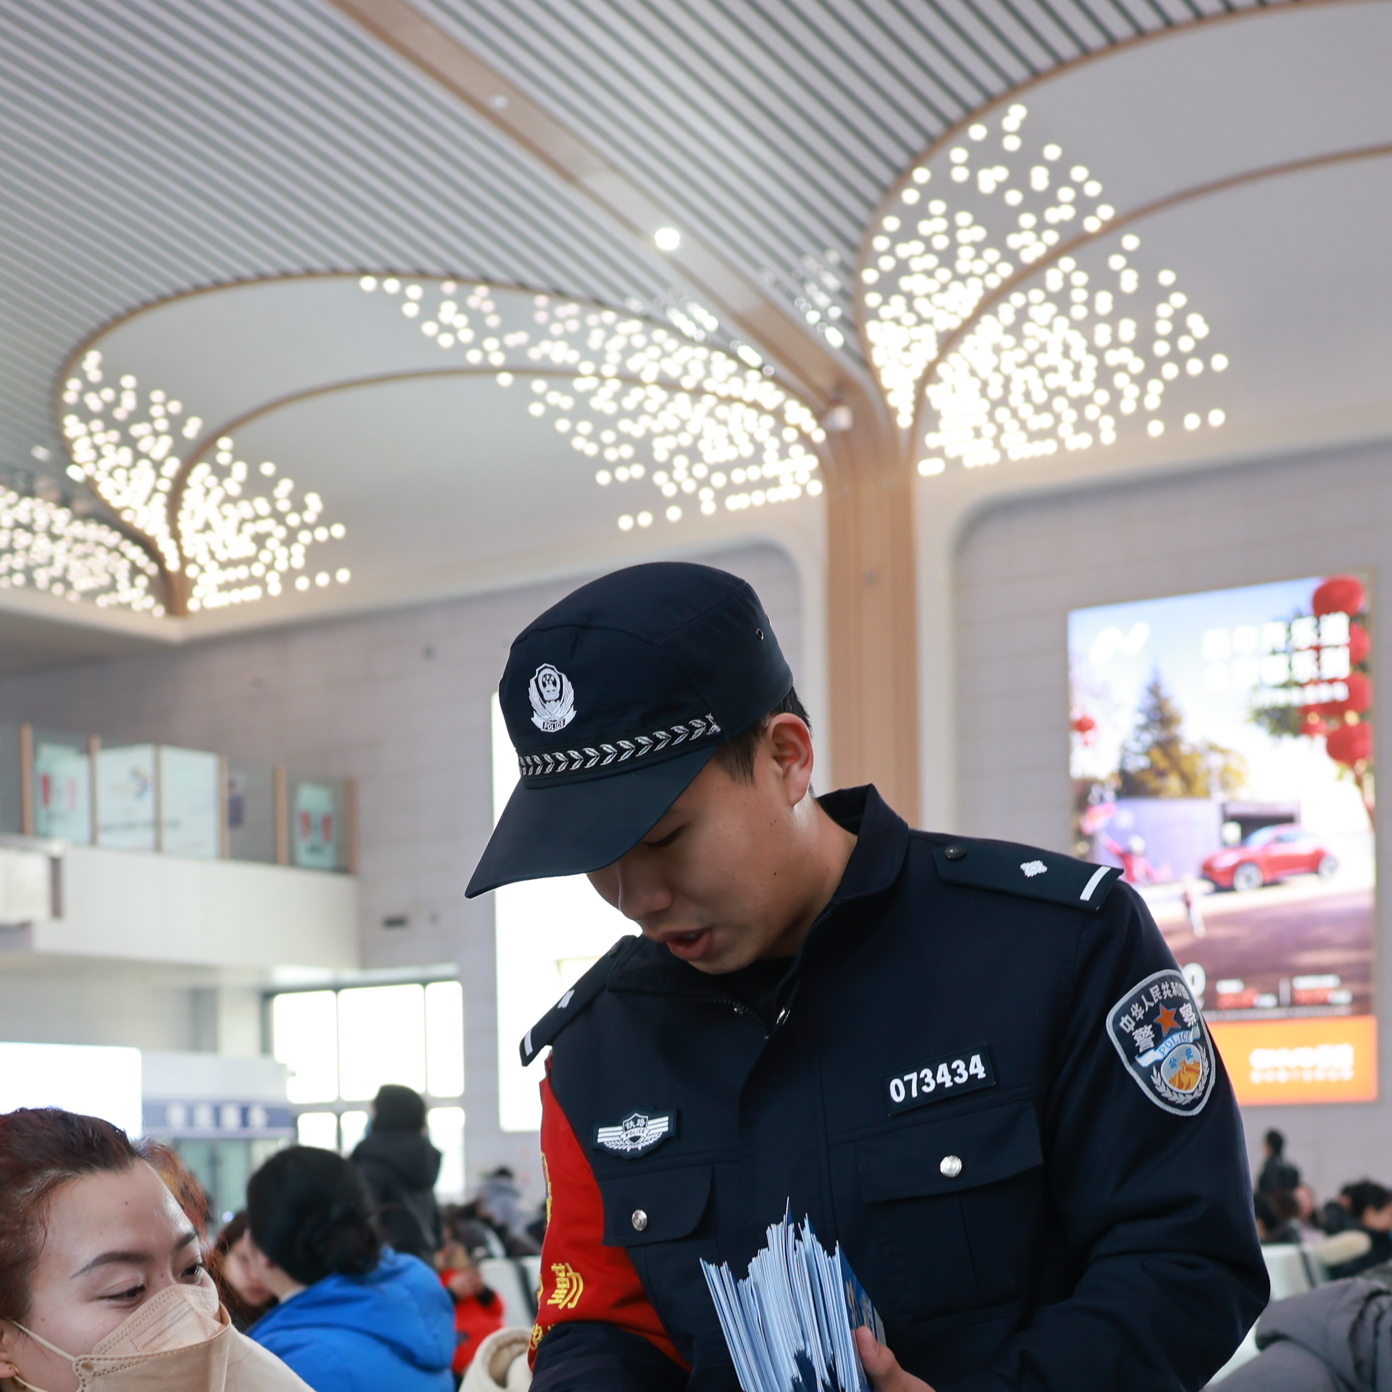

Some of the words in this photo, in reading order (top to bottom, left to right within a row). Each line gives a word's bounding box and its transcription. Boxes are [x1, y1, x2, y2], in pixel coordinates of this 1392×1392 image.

[542, 719, 566, 730] POLICE
[1119, 980, 1190, 1033] 中华人民共和国
[1159, 1032, 1191, 1056] POLICE
[889, 1053, 986, 1103] 073434
[624, 1129, 646, 1138] POLICE
